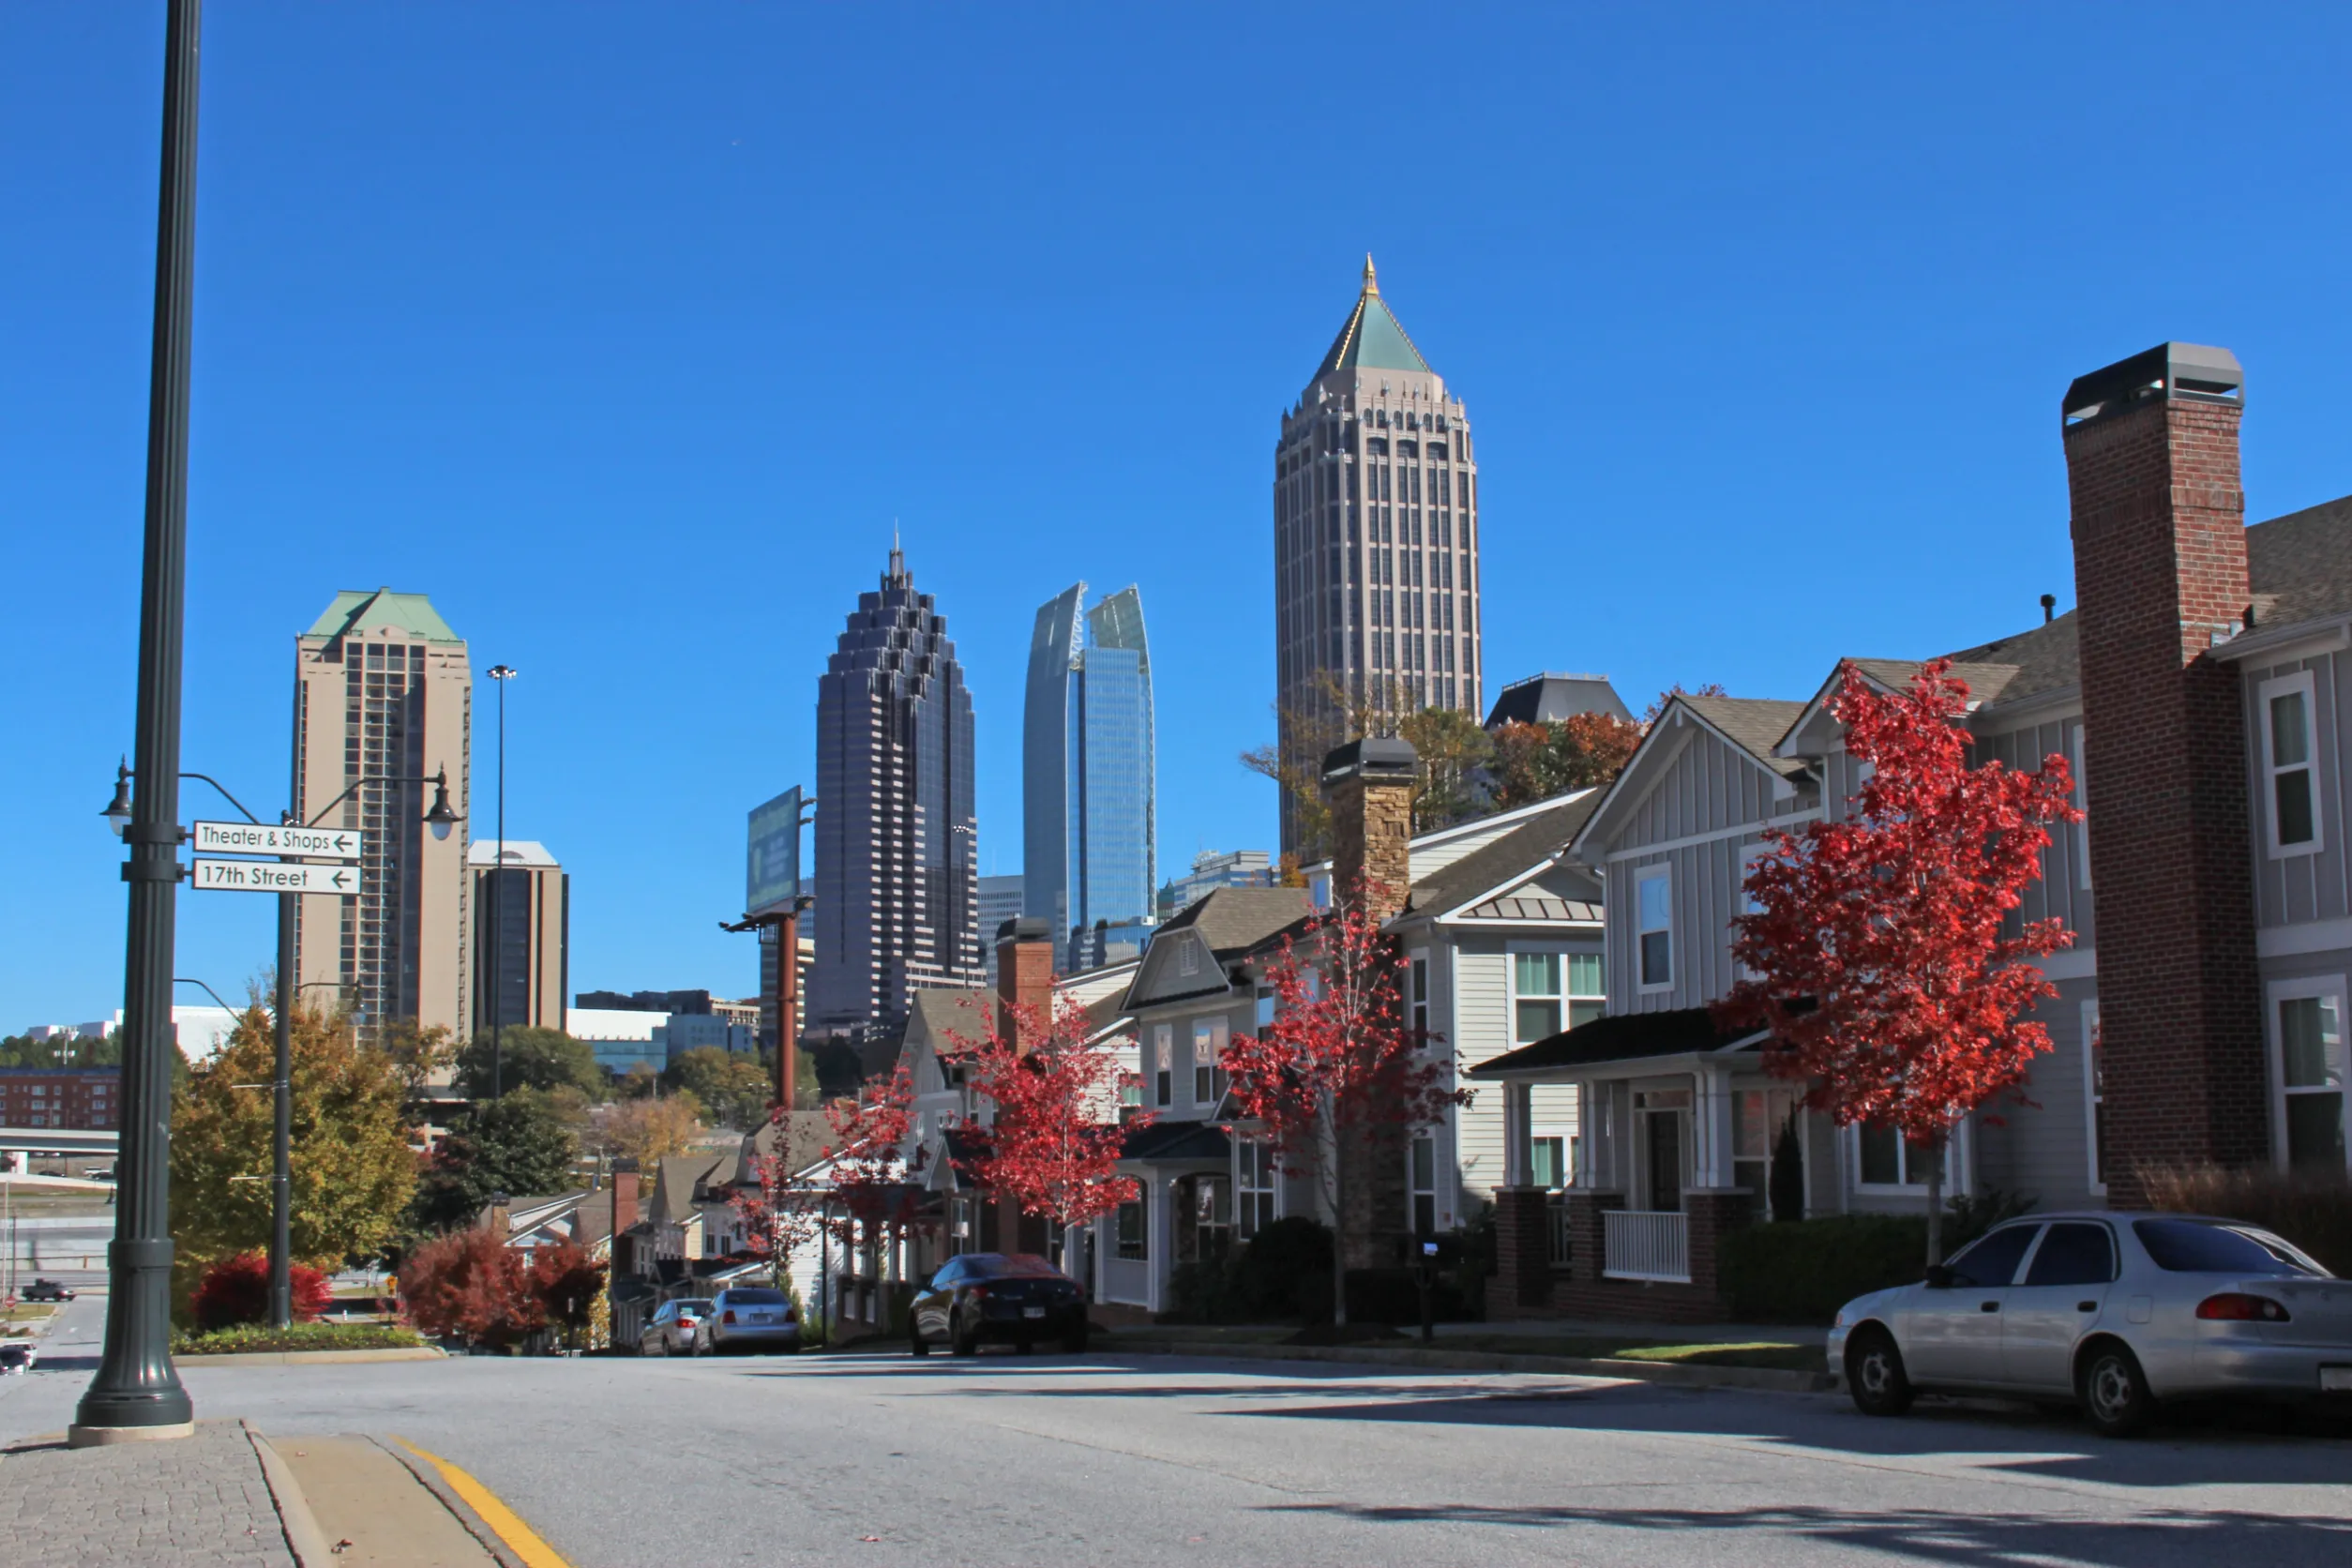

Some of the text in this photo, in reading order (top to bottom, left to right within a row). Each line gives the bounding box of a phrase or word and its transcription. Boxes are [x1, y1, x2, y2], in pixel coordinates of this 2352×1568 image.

[203, 826, 329, 852] Theater & Shops
[204, 866, 308, 886] 17th Street
